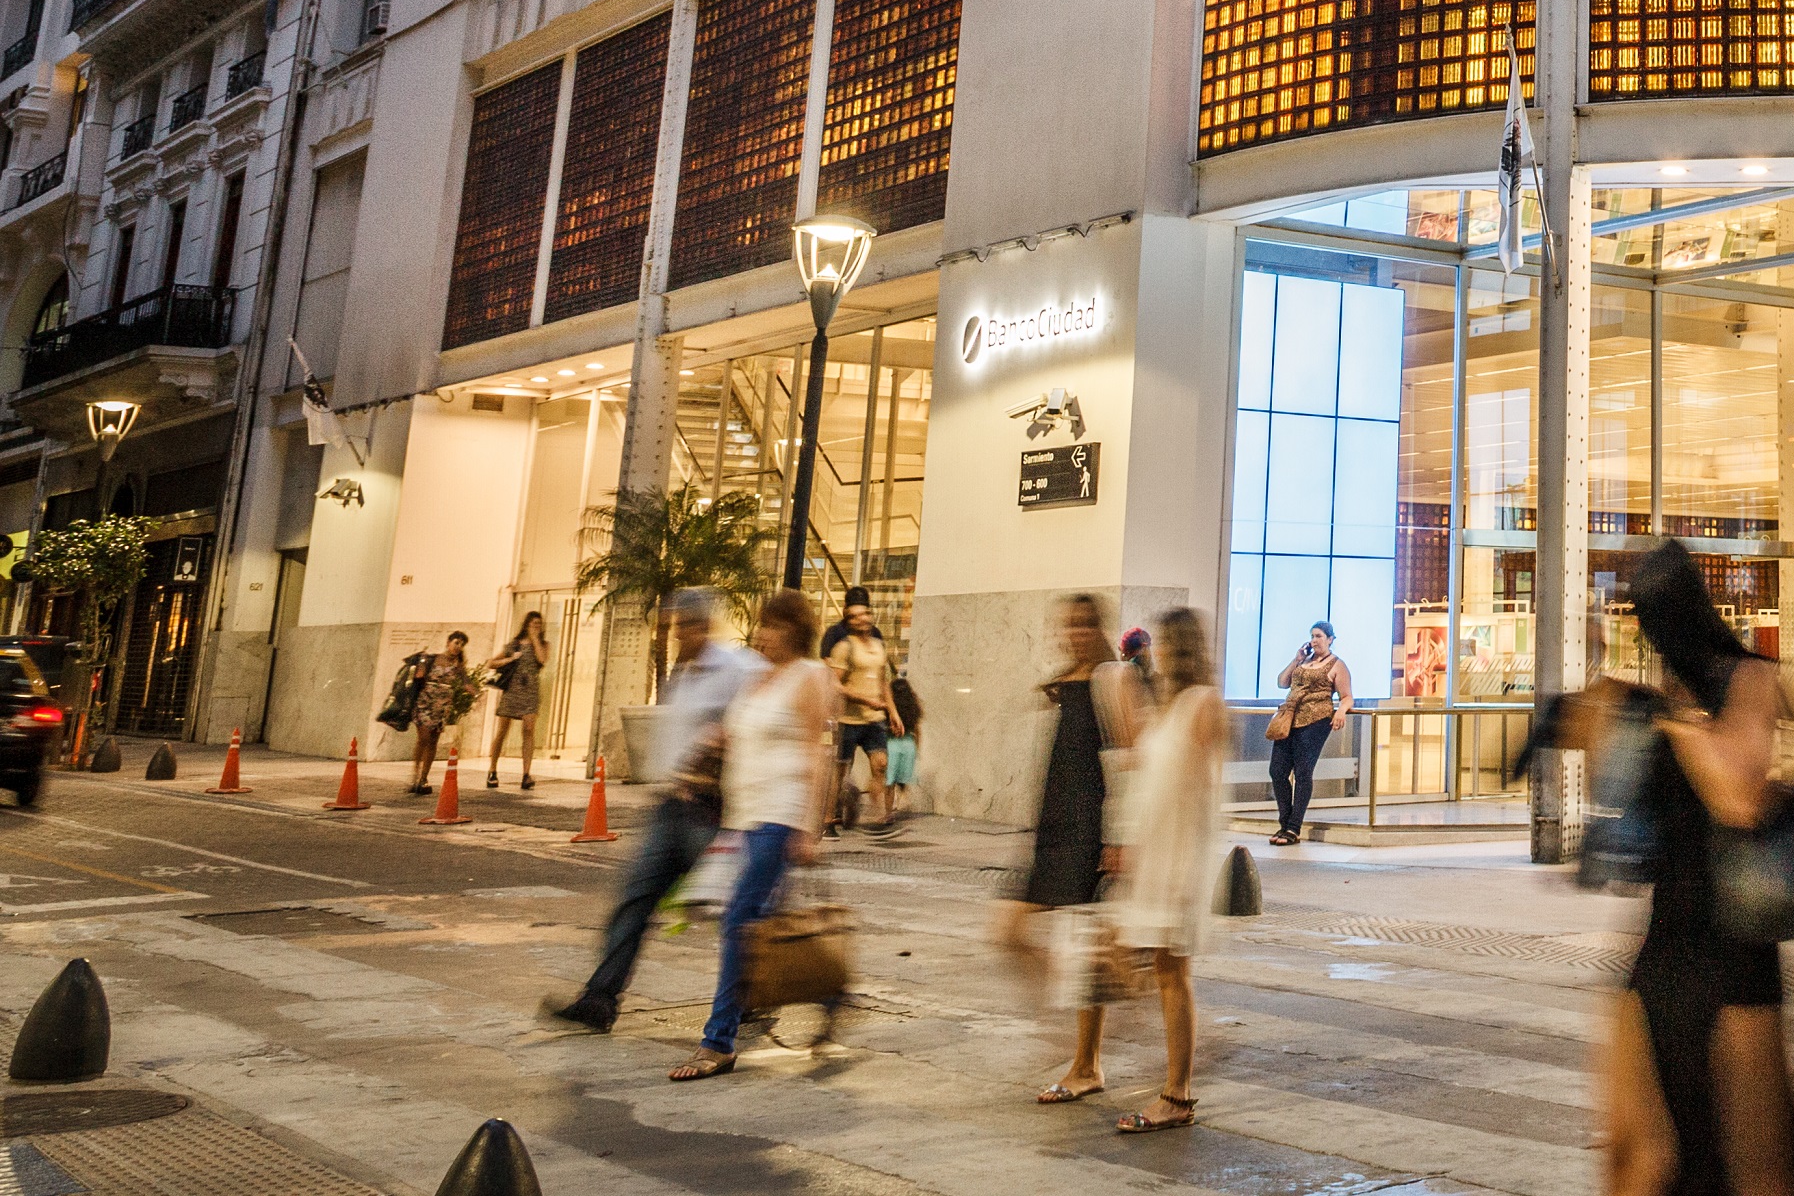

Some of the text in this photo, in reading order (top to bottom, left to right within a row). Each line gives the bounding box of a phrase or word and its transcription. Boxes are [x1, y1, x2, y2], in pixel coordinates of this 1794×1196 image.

[987, 297, 1095, 348] BancoCiudad
[1023, 452, 1054, 465] Sarmiento
[1021, 480, 1032, 491] 700
[1036, 478, 1048, 489] 600
